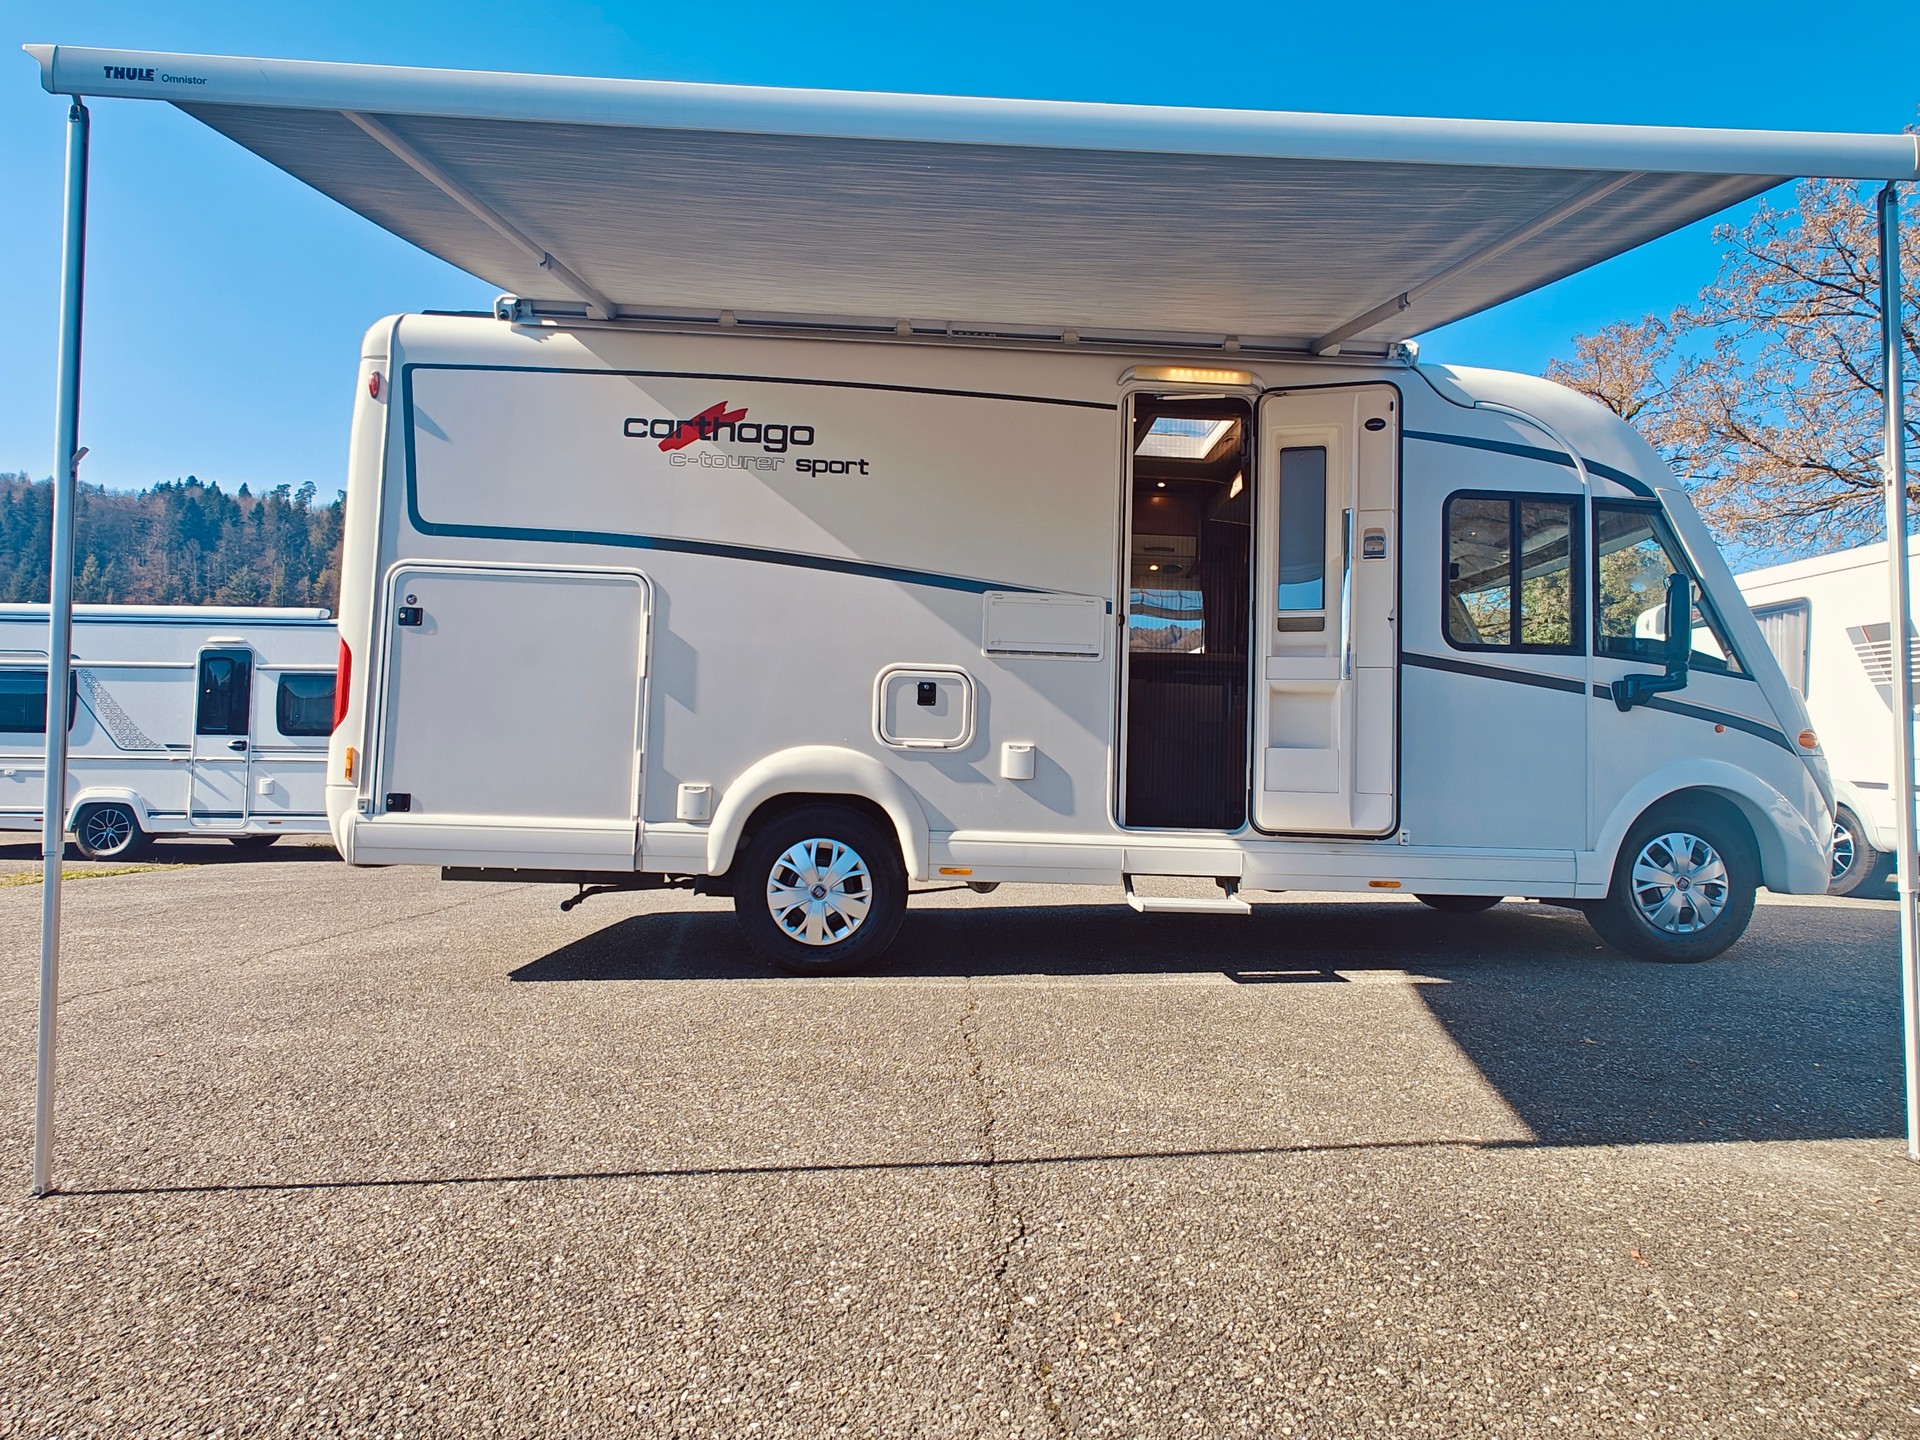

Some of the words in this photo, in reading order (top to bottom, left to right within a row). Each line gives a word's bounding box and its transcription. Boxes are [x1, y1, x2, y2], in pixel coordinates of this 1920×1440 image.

[103, 65, 155, 82] THULE
[161, 73, 208, 86] Omnistor
[623, 415, 815, 453] carthago
[669, 451, 786, 472] c-tourer
[795, 456, 870, 478] sport
